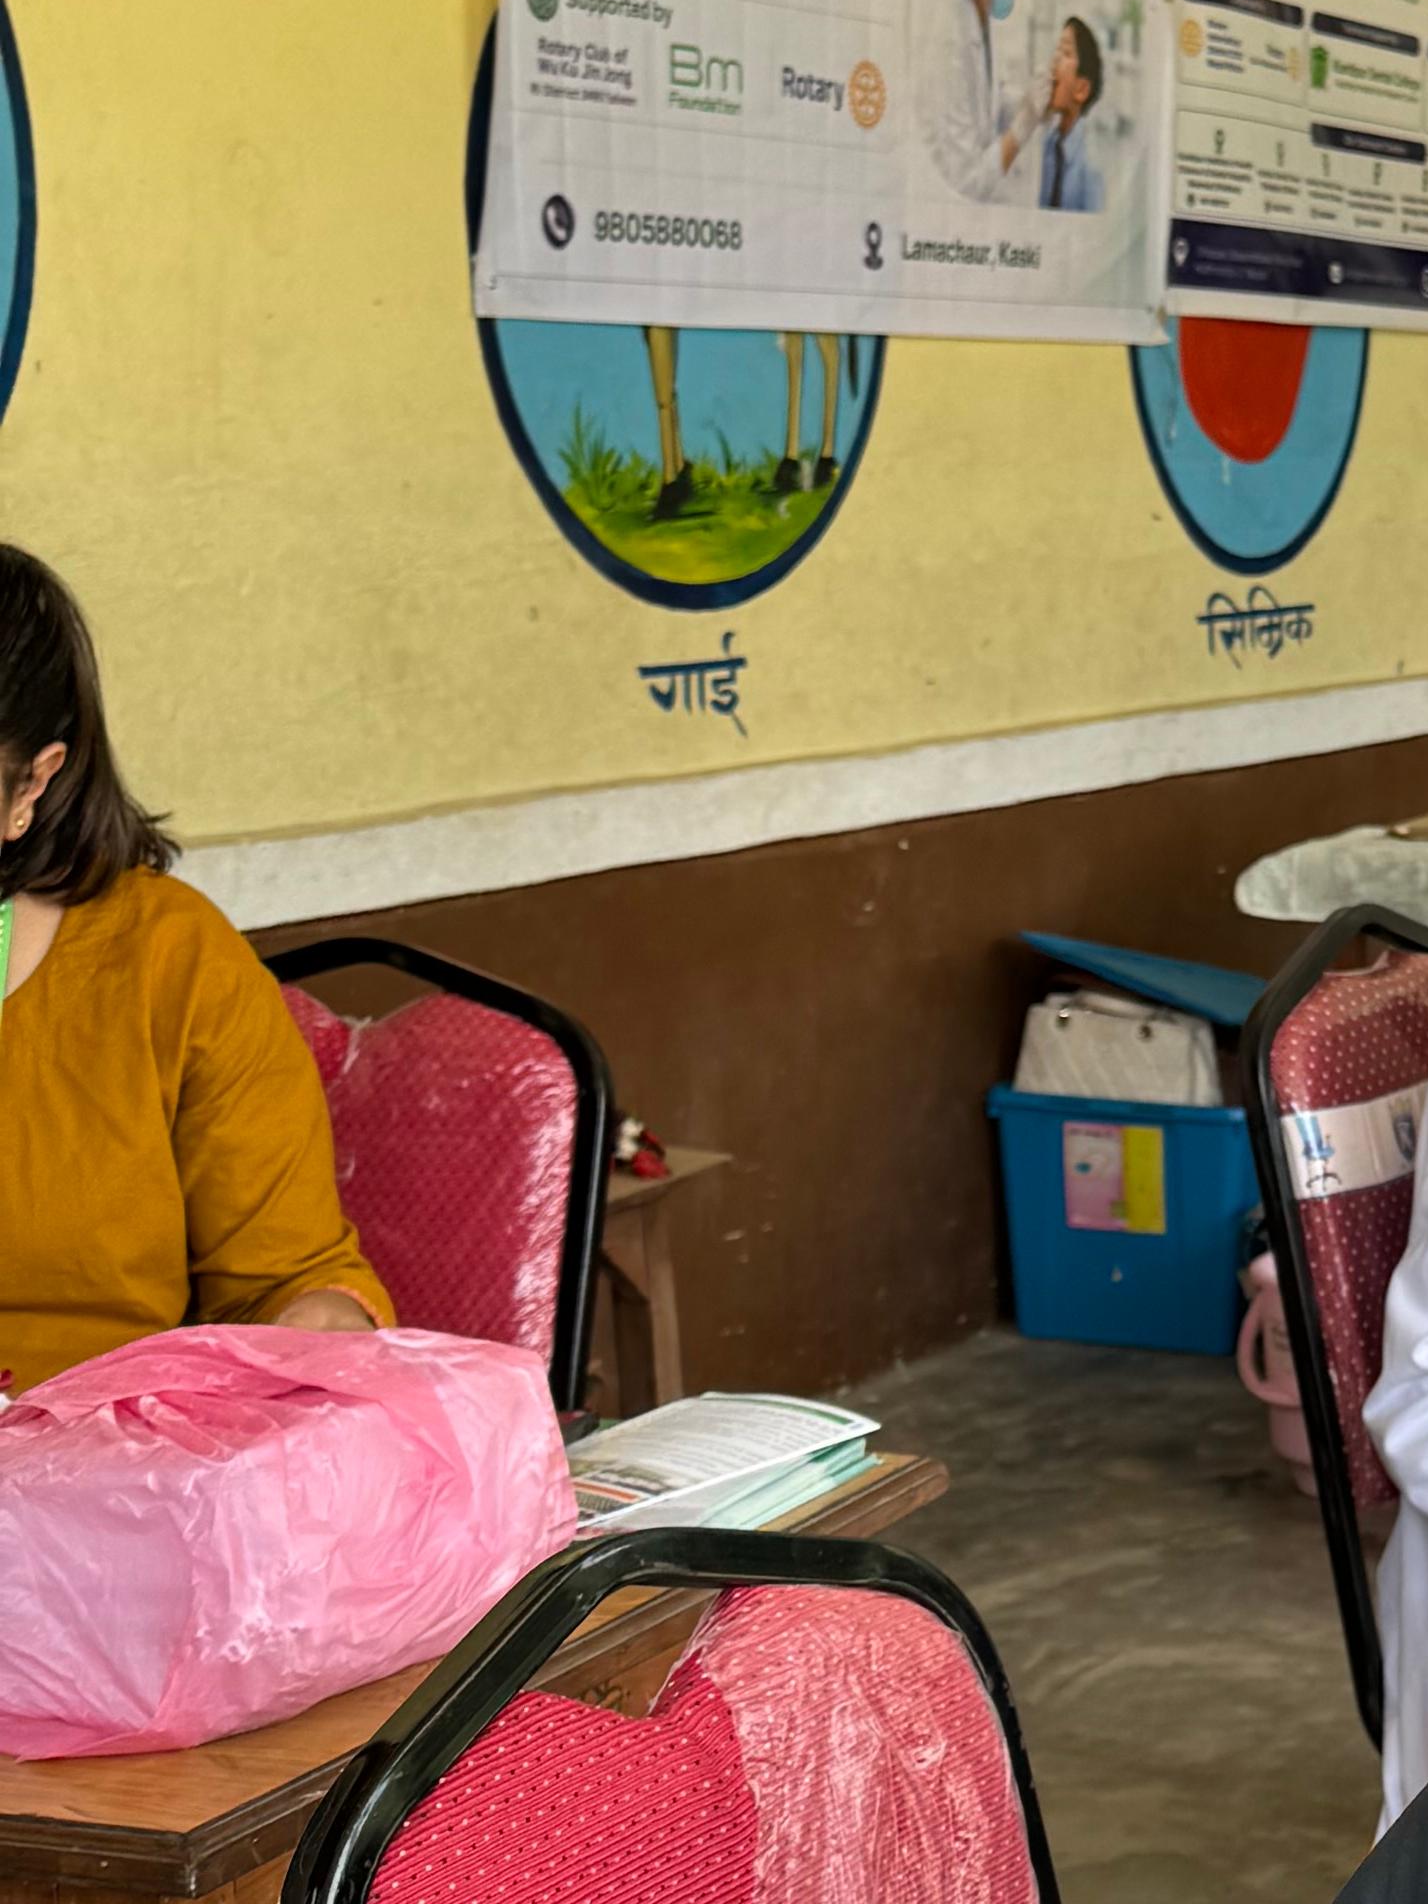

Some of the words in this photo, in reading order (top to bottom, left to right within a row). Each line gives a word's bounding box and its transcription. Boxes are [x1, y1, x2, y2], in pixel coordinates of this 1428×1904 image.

[652, 1, 674, 29] by
[782, 65, 846, 112] Rotary
[668, 91, 742, 117] Foundation
[999, 241, 1041, 271] Kaski
[637, 631, 749, 737] गाई
